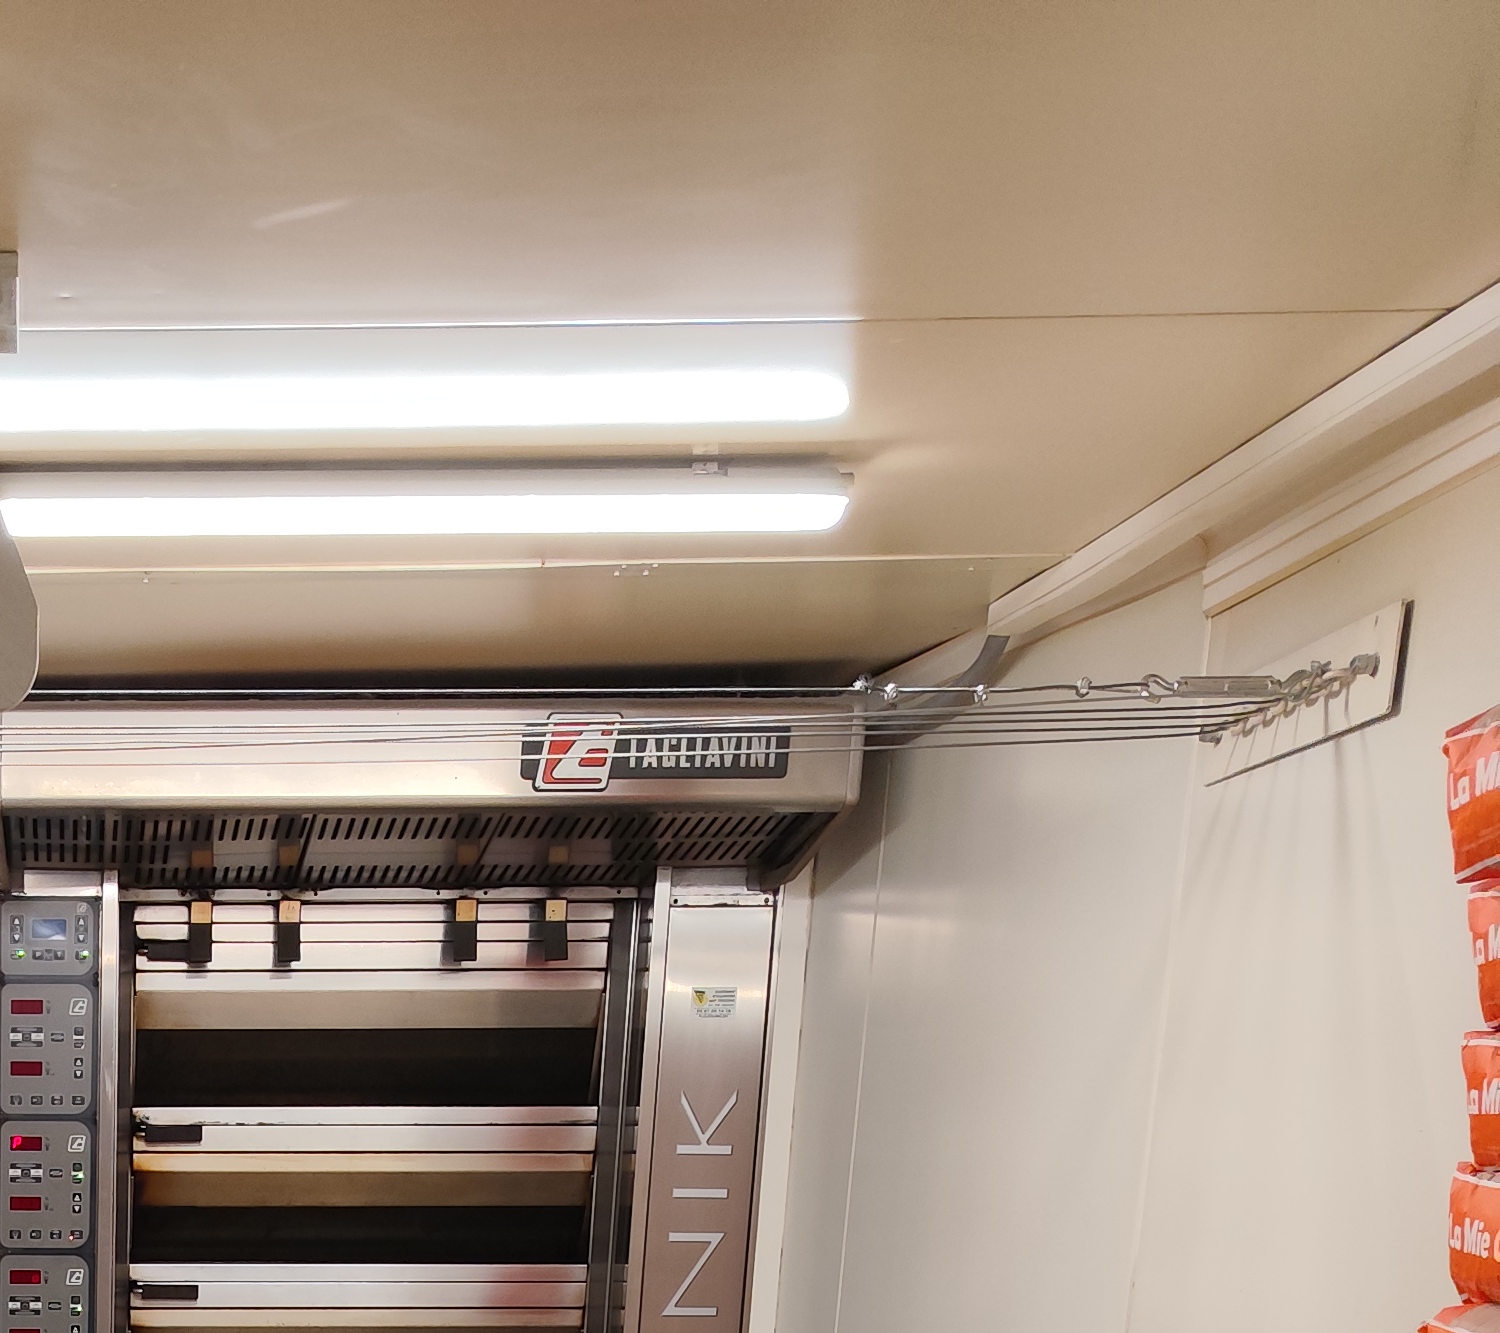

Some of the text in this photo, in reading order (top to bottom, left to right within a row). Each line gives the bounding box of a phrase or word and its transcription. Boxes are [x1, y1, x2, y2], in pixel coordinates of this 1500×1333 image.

[628, 734, 778, 770] TAGLIAVINI
[1449, 772, 1471, 811] La
[1463, 1217, 1491, 1259] Mie
